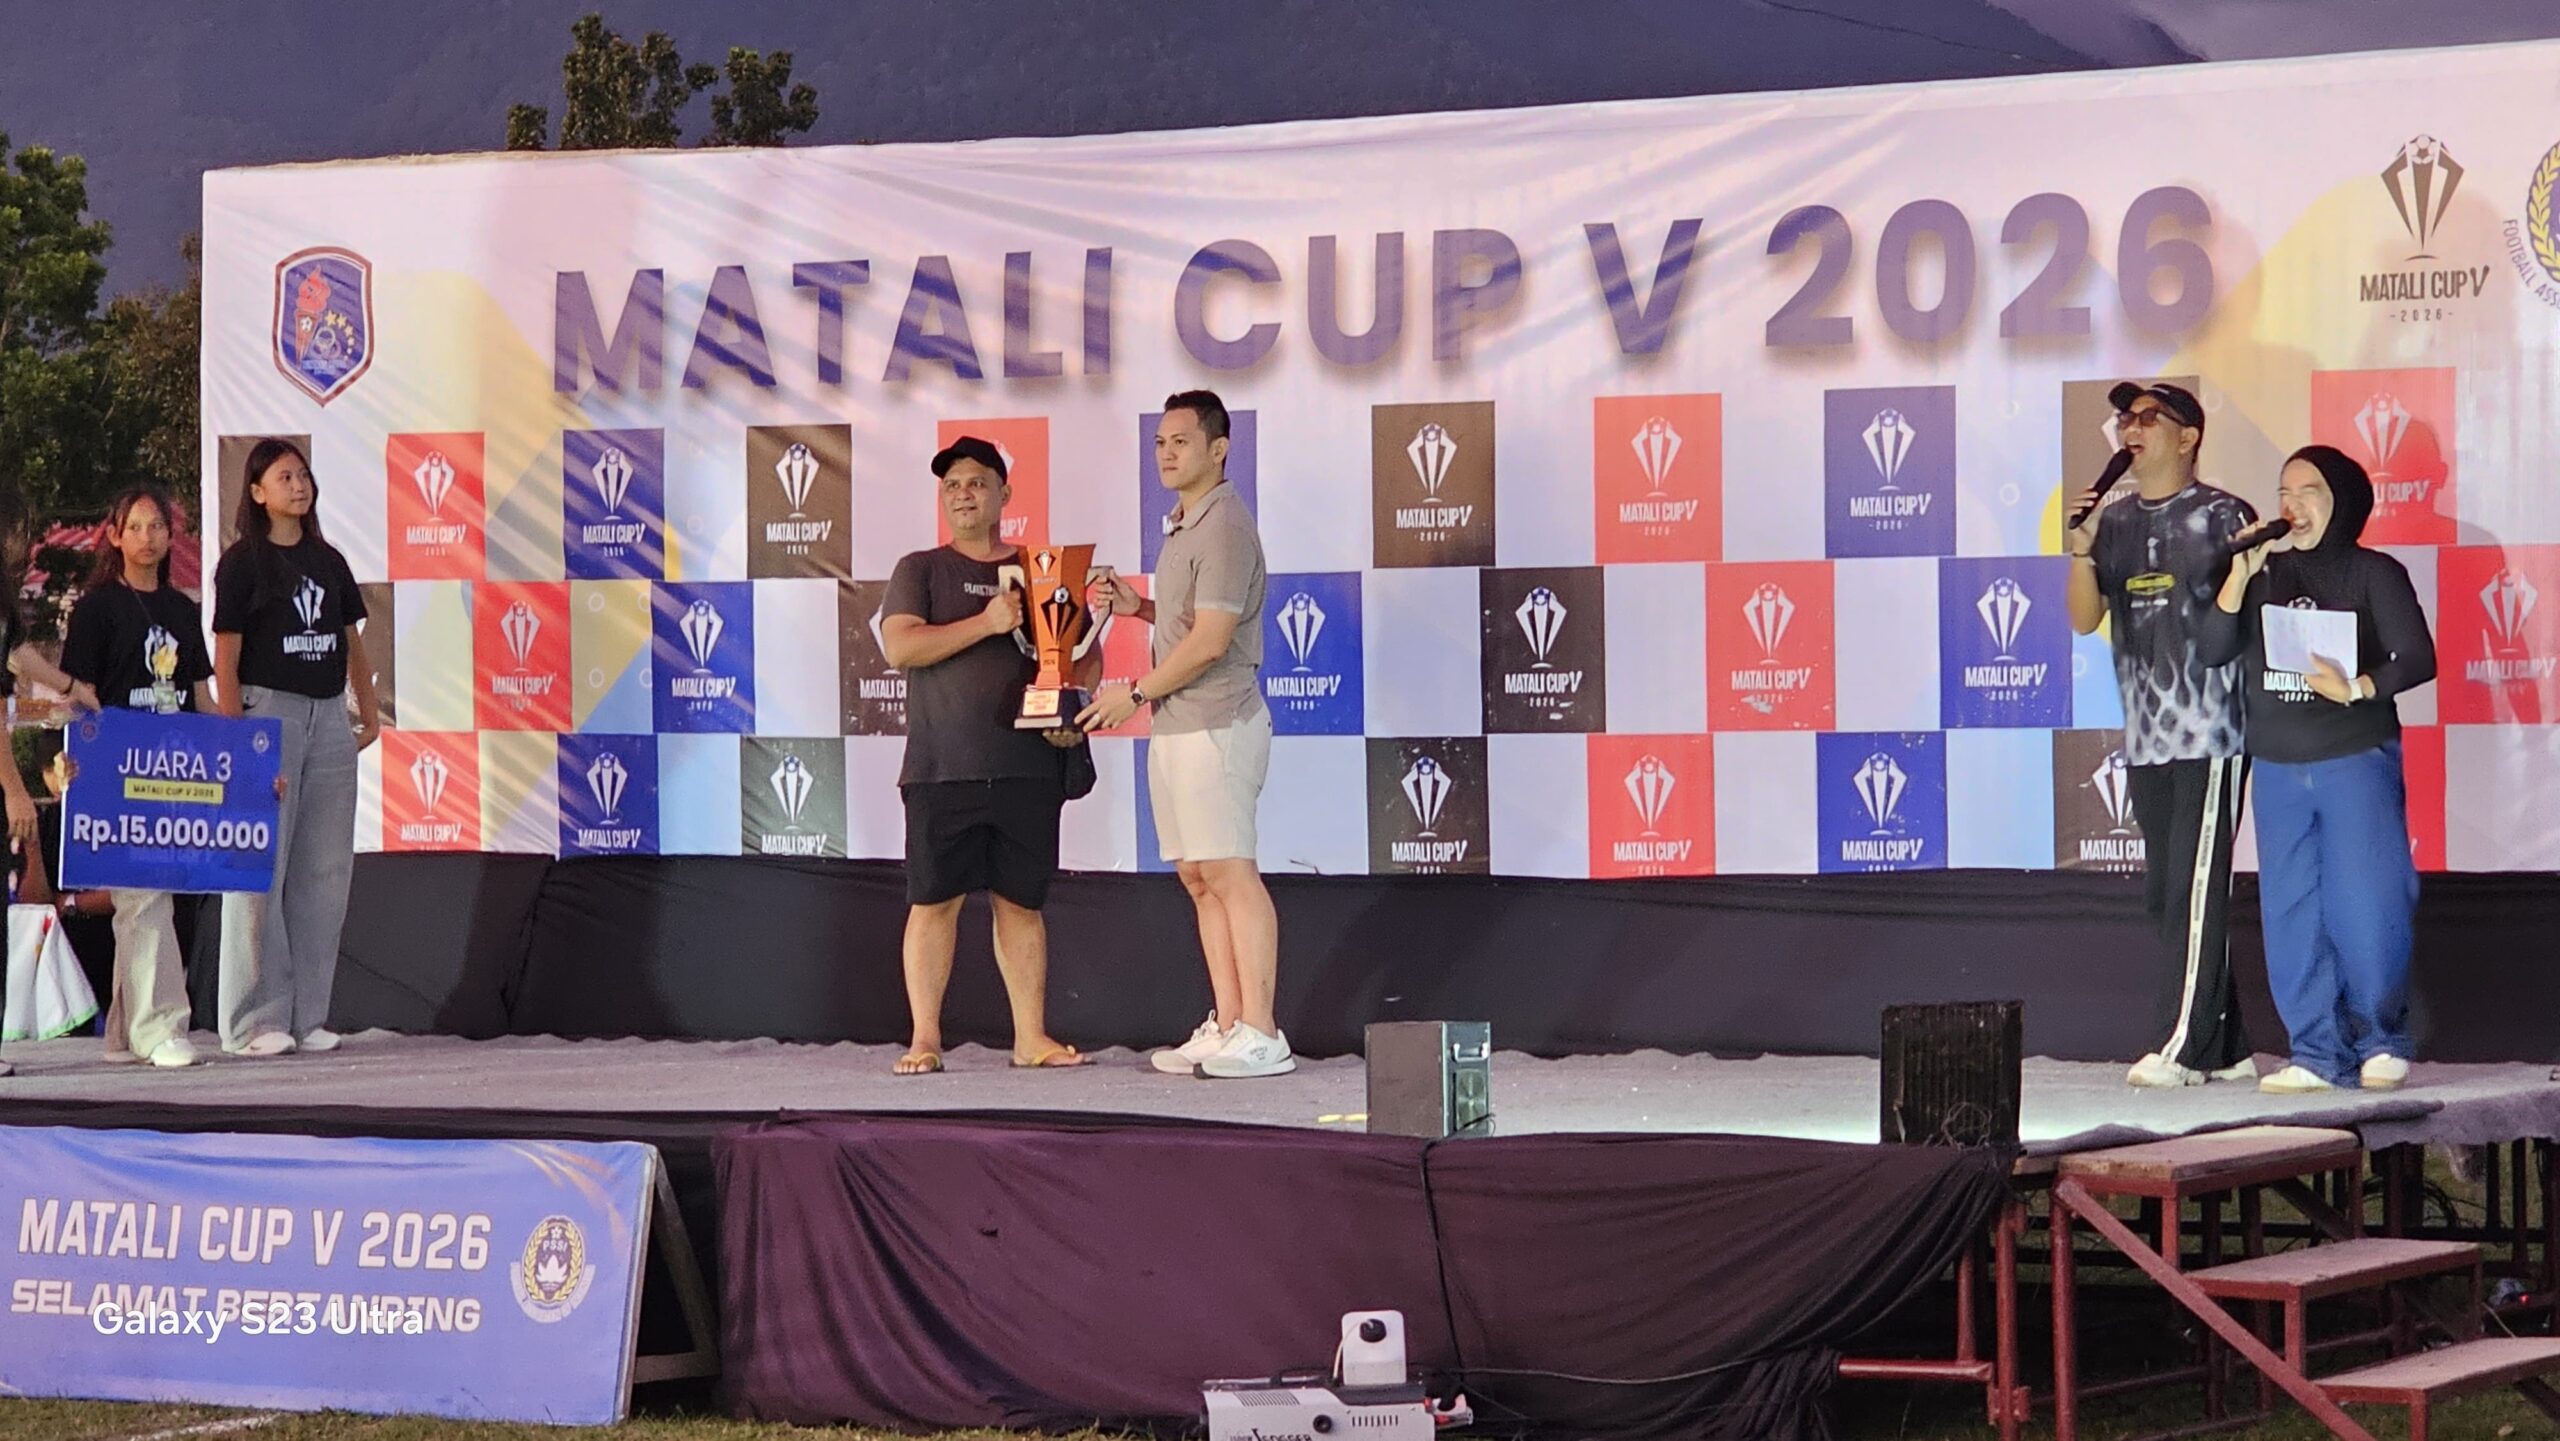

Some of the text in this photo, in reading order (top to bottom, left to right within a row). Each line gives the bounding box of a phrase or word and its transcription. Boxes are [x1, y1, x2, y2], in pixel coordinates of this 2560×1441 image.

[2503, 218, 2537, 288] FOOTBALL
[554, 186, 2215, 393] MATALI CUP V 2026
[2360, 272, 2425, 301] MATALI
[1620, 502, 1659, 523] MATALI
[1850, 496, 1890, 517] MATALI
[1396, 508, 1434, 528] MATALI
[583, 525, 615, 544] MATALI
[766, 522, 800, 542] MATALI
[1266, 676, 1304, 697] MATALI
[1505, 673, 1545, 693] MATALI
[1731, 670, 1771, 691] MATALI
[1964, 666, 2005, 687] MATALI
[671, 678, 705, 697] MATALI
[859, 679, 895, 699] MATALI
[118, 748, 232, 782] JUARA 3
[166, 787, 183, 796] CUP
[73, 813, 269, 851] Rp.15.000.000
[578, 829, 611, 848] MATALI
[761, 834, 796, 855] MATALI
[1391, 842, 1430, 862] MATALI
[1613, 841, 1653, 862] MATALI
[1842, 840, 1882, 861] MATALI
[2080, 839, 2123, 860] MATALI
[18, 1198, 491, 1270] MATALI CUP V 2026
[543, 1240, 568, 1252] PSSI
[11, 1279, 207, 1320] SELAMAT
